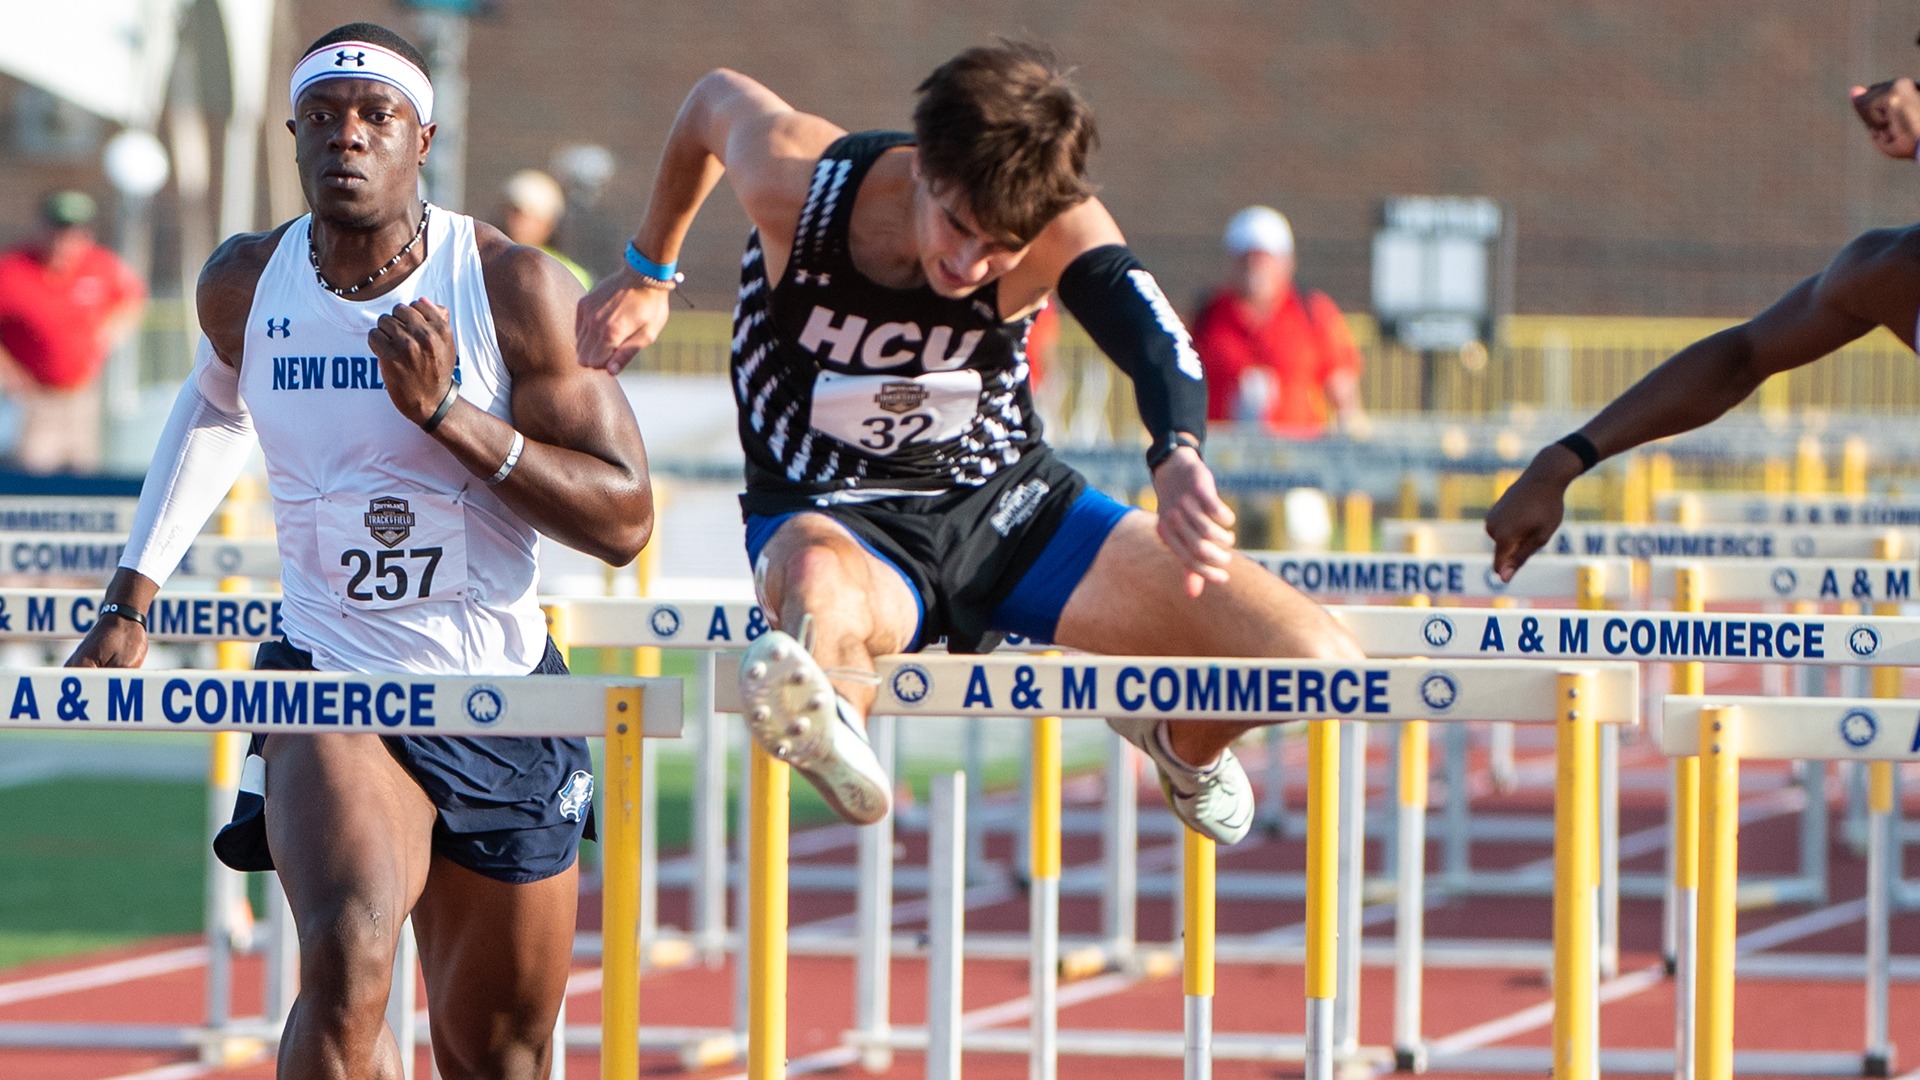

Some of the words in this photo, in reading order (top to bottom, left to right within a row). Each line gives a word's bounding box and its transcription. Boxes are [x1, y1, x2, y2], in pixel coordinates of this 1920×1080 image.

[798, 305, 985, 371] HCU
[272, 357, 326, 390] NEW
[859, 413, 933, 450] 32
[340, 546, 443, 601] 257
[1821, 568, 1839, 597] A
[1852, 568, 1872, 598] &
[1886, 570, 1910, 597] M
[27, 597, 56, 632] M
[707, 605, 732, 641] A
[1479, 616, 1505, 652] A
[1518, 616, 1545, 653] &
[1559, 618, 1588, 653] M
[1603, 618, 1824, 658] COMMERCE
[9, 676, 41, 720] A
[57, 676, 90, 722] &
[107, 678, 144, 722] M
[161, 678, 435, 727] COMMERCE
[963, 665, 993, 708] A
[1011, 665, 1043, 710] &
[1062, 667, 1097, 709] M
[1115, 666, 1390, 714] COMMERCE
